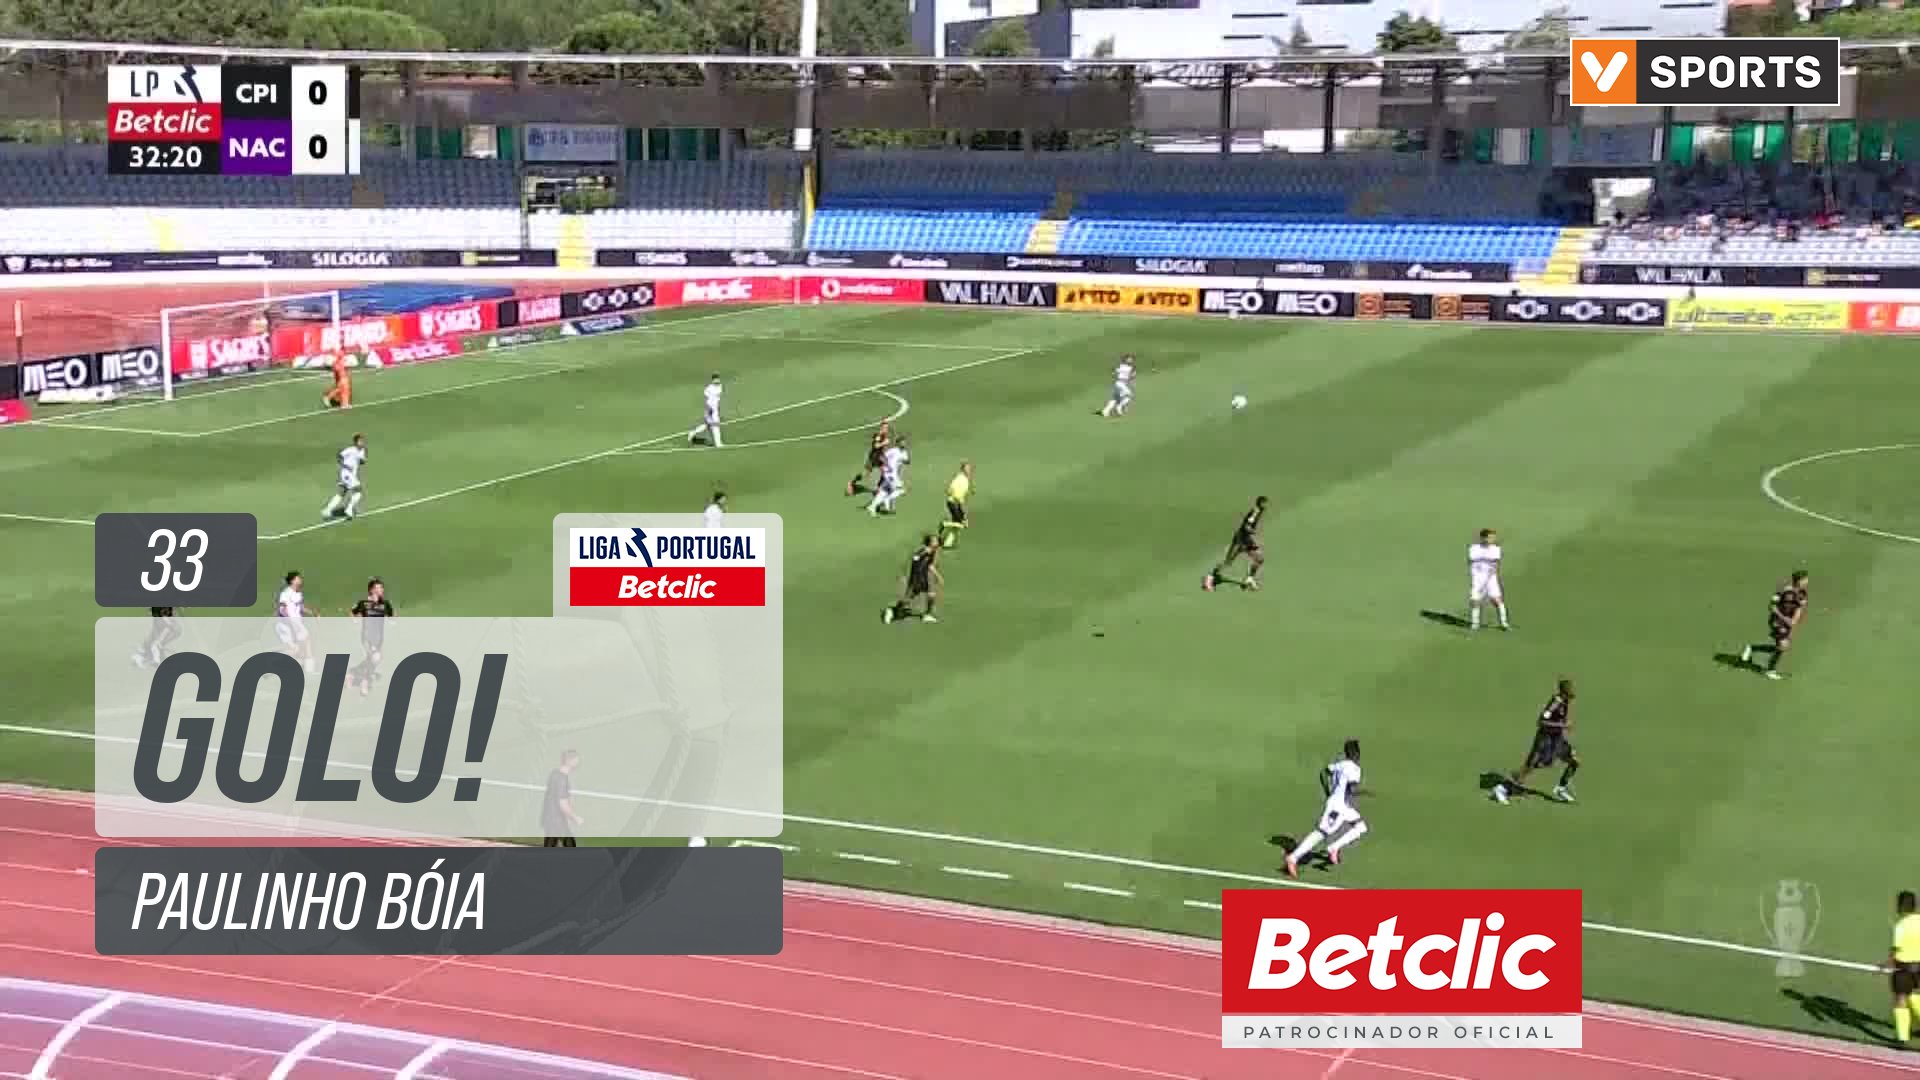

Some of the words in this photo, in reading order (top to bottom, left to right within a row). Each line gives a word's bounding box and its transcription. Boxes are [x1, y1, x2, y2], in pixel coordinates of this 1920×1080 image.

[1135, 258, 1207, 272] SILOGIA
[1203, 290, 1263, 312] MEO
[1276, 290, 1338, 315] MEO
[23, 358, 87, 391] MEO
[102, 350, 159, 381] MEO
